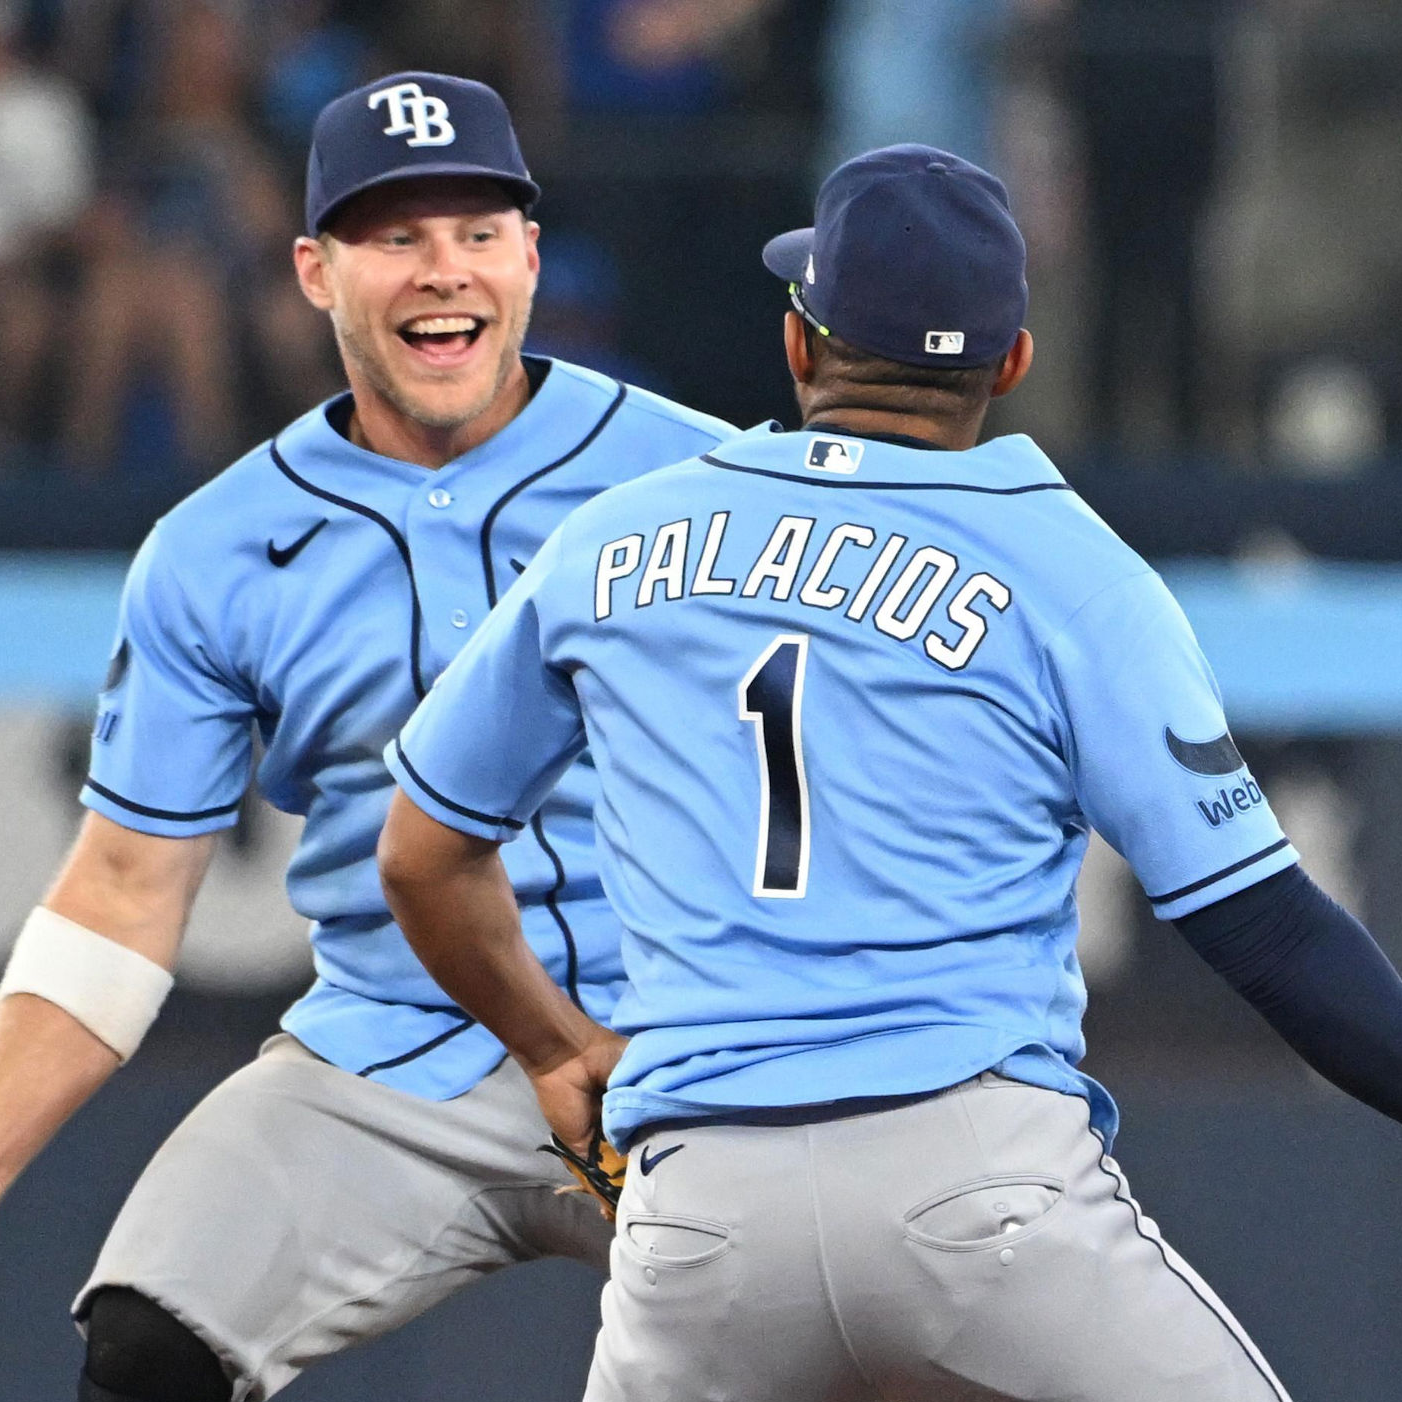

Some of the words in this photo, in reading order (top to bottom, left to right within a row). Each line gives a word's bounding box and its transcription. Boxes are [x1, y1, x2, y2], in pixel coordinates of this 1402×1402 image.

[368, 83, 456, 148] TB
[595, 511, 1011, 671] PALACIOS
[738, 634, 811, 898] 1
